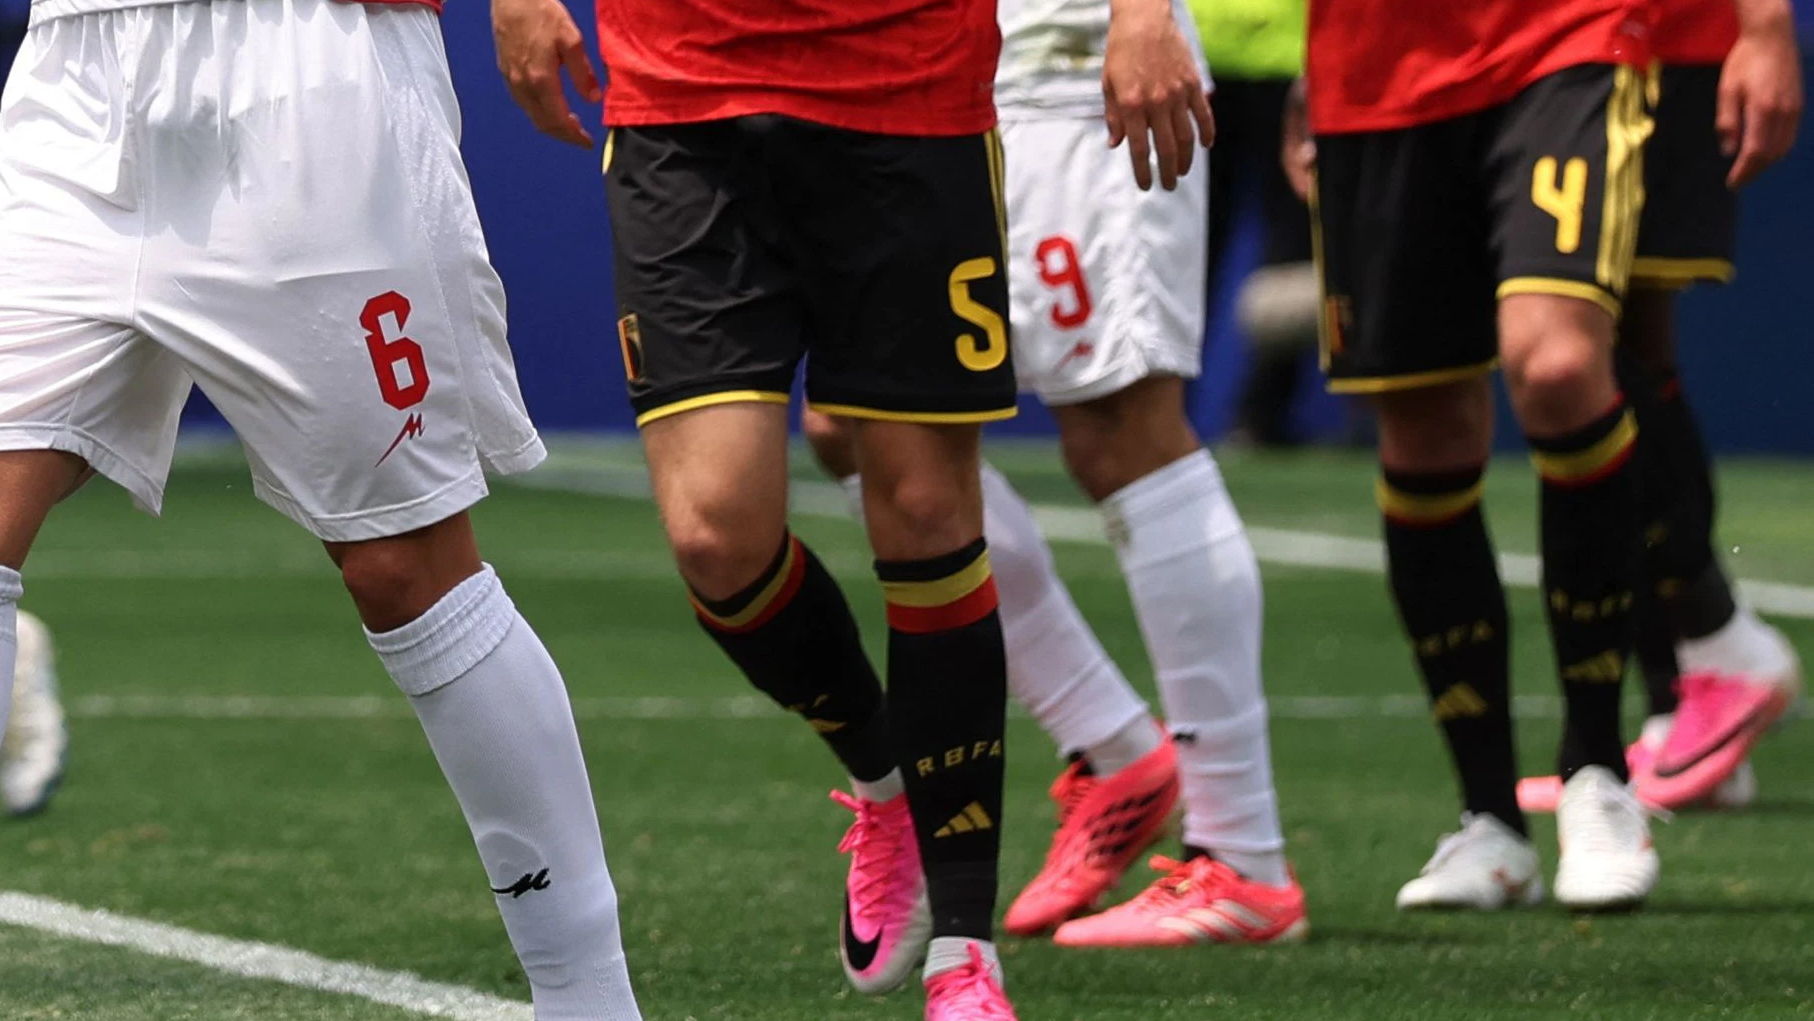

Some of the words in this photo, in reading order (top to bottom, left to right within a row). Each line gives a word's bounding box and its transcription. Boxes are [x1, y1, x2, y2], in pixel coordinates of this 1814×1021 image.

[1530, 155, 1588, 254] 4
[949, 256, 1007, 371] 5
[1034, 235, 1094, 330] 9
[358, 290, 431, 411] 6
[915, 739, 1002, 777] RBFA
